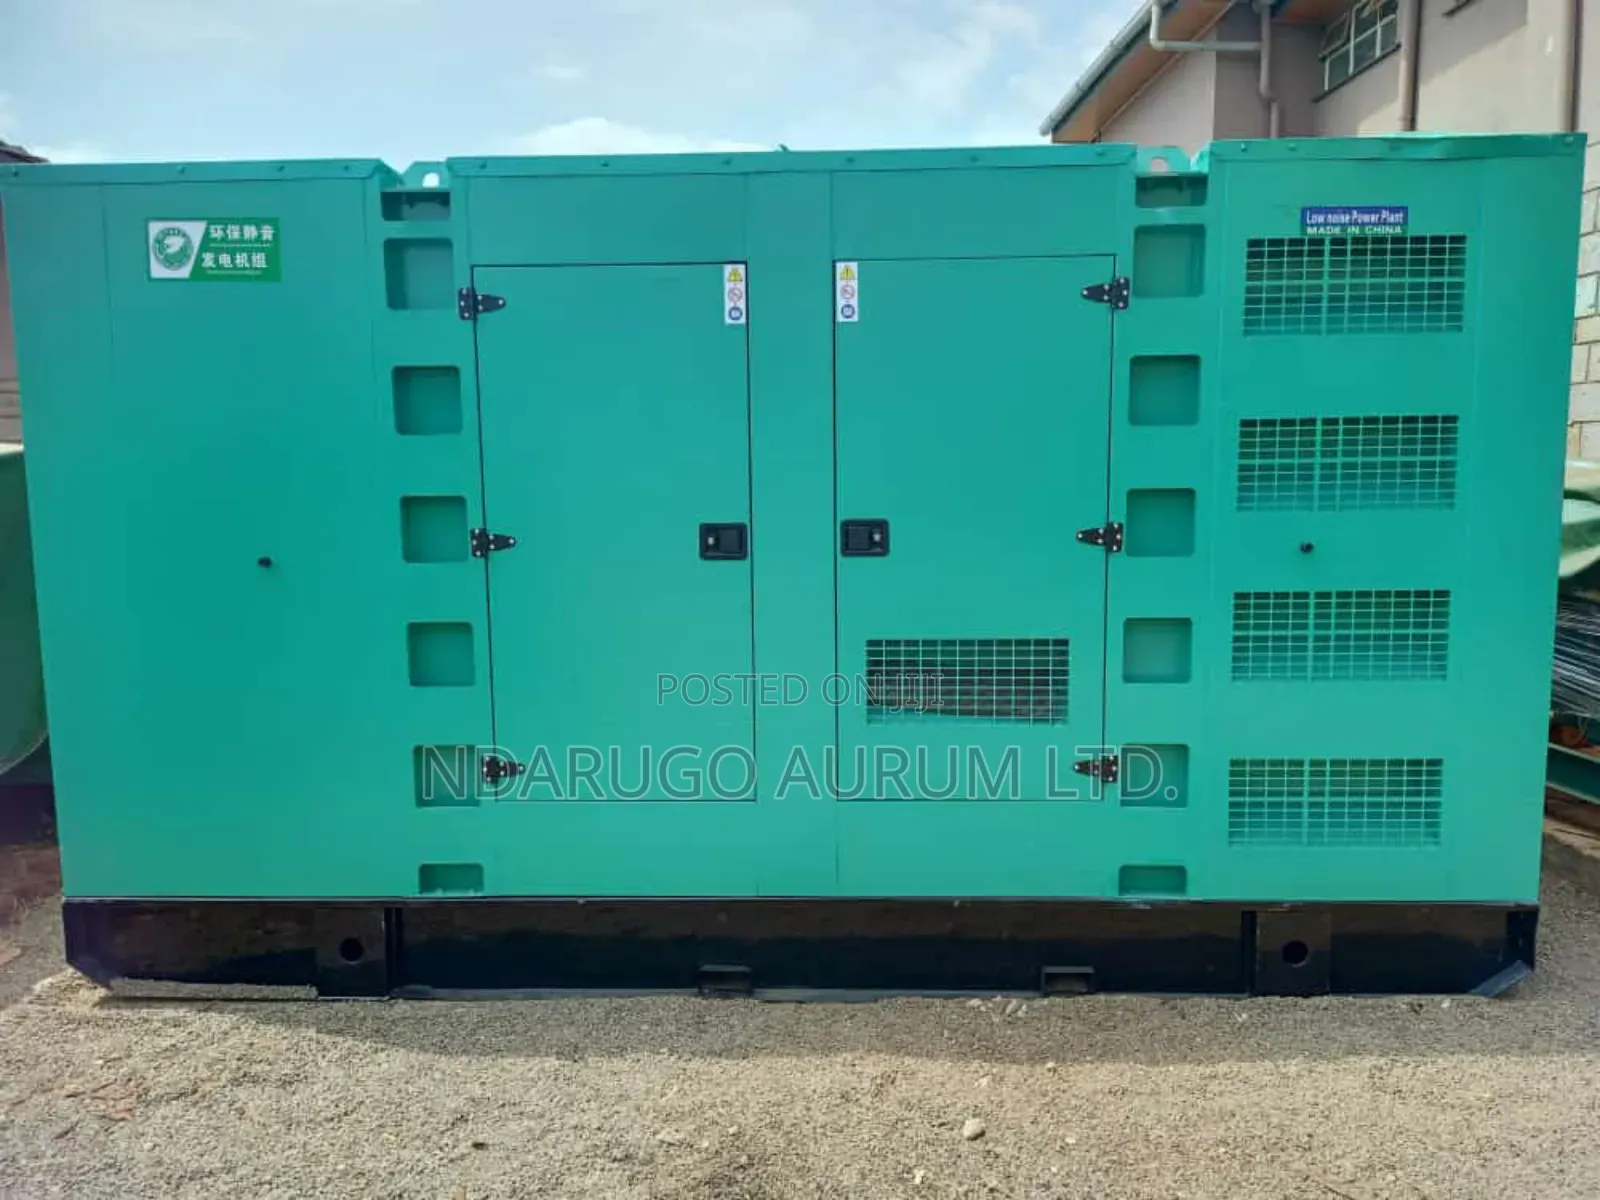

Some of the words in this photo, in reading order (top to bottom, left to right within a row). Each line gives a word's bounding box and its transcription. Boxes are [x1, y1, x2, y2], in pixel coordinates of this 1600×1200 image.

[1306, 209, 1325, 224] Low
[1327, 211, 1350, 223] noise
[1351, 209, 1379, 224] Power
[1380, 208, 1404, 223] Plant
[208, 224, 276, 241] 环保静音
[1306, 226, 1341, 235] MADE
[1347, 226, 1360, 235] IN
[1365, 226, 1402, 235] CHINA
[201, 252, 268, 268] 发电机组
